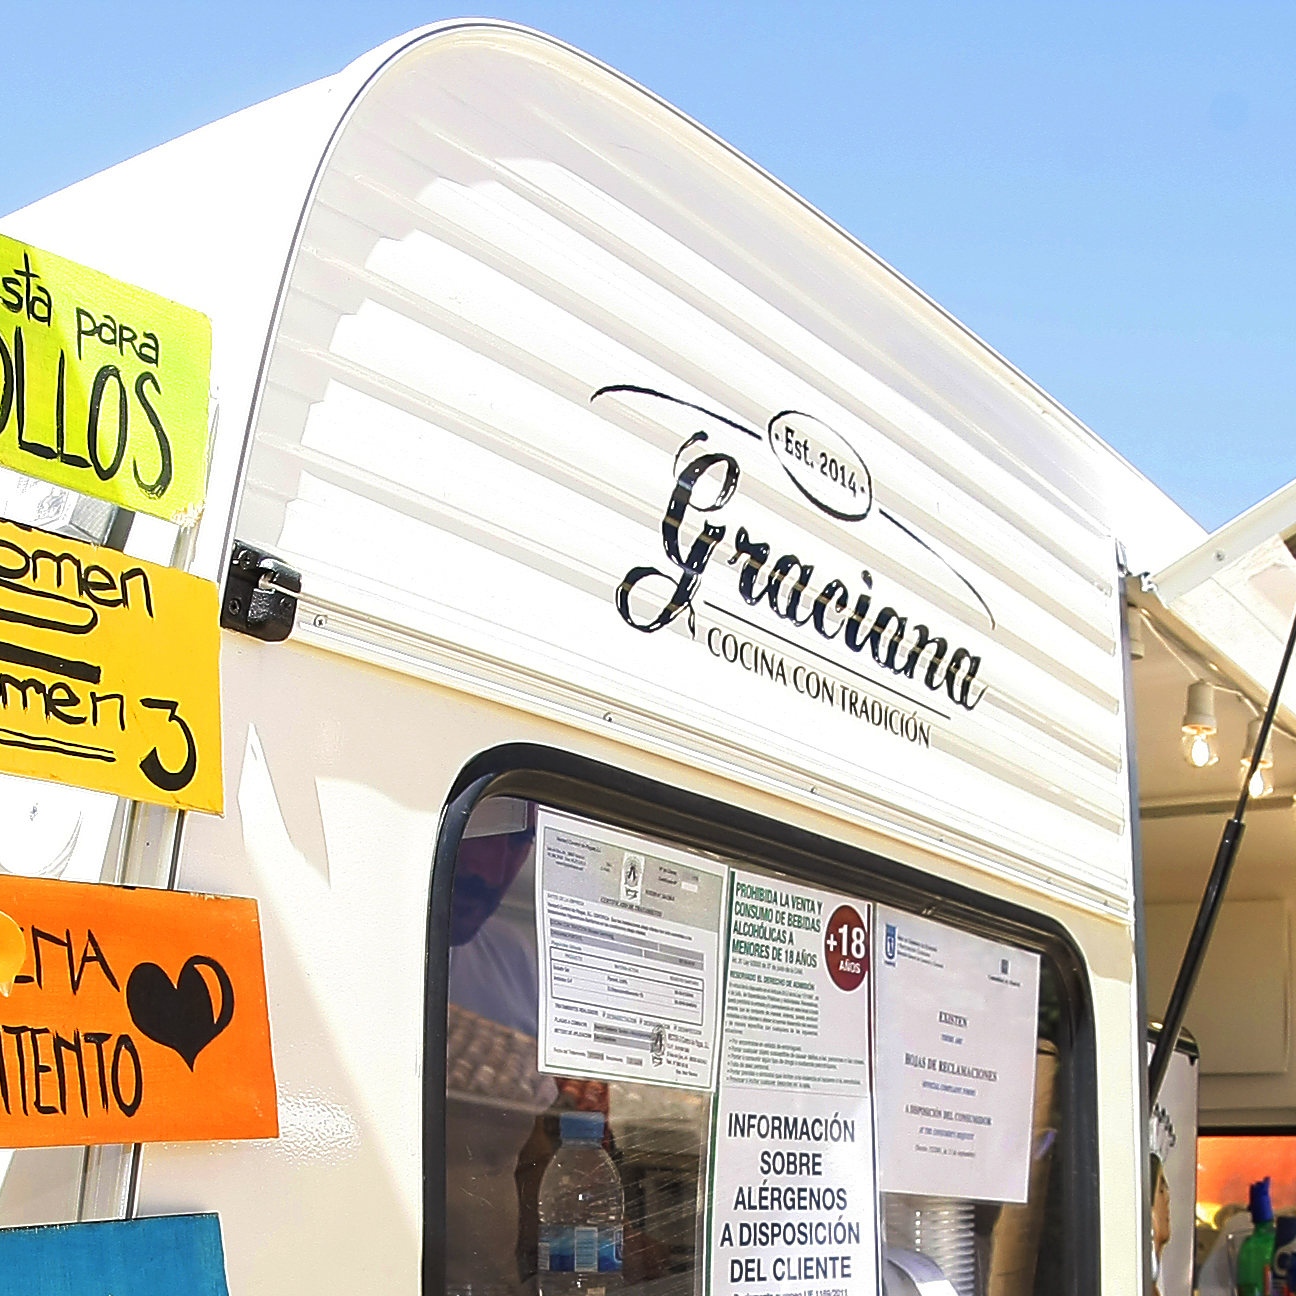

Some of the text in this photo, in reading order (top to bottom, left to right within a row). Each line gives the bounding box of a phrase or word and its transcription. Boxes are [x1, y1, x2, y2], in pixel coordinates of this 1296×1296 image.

[785, 425, 856, 498] Est. 2014
[615, 431, 989, 711] Graciana
[708, 627, 931, 748] COCINA CON TRADICIÓN
[139, 698, 197, 791] 3
[735, 882, 824, 915] PROHIBIDA LA VENTA Y
[733, 920, 794, 945] ALCOHÓLICAS A
[735, 901, 821, 933] CONSUMO DE BEBIDAS
[732, 939, 769, 960] MENORES
[772, 946, 783, 962] DE
[784, 948, 794, 964] 18
[795, 949, 817, 968] AÑOS
[826, 924, 866, 960] +18
[839, 959, 861, 974] AÑOS
[927, 1058, 937, 1071] DE
[728, 1112, 855, 1142] INFORMACIÓN
[760, 1151, 822, 1176] SOBRE
[733, 1179, 847, 1211] ALÉRGENOS
[720, 1215, 860, 1247] A DISPOSICIÓN
[730, 1255, 852, 1283] DEL CLIENTE
